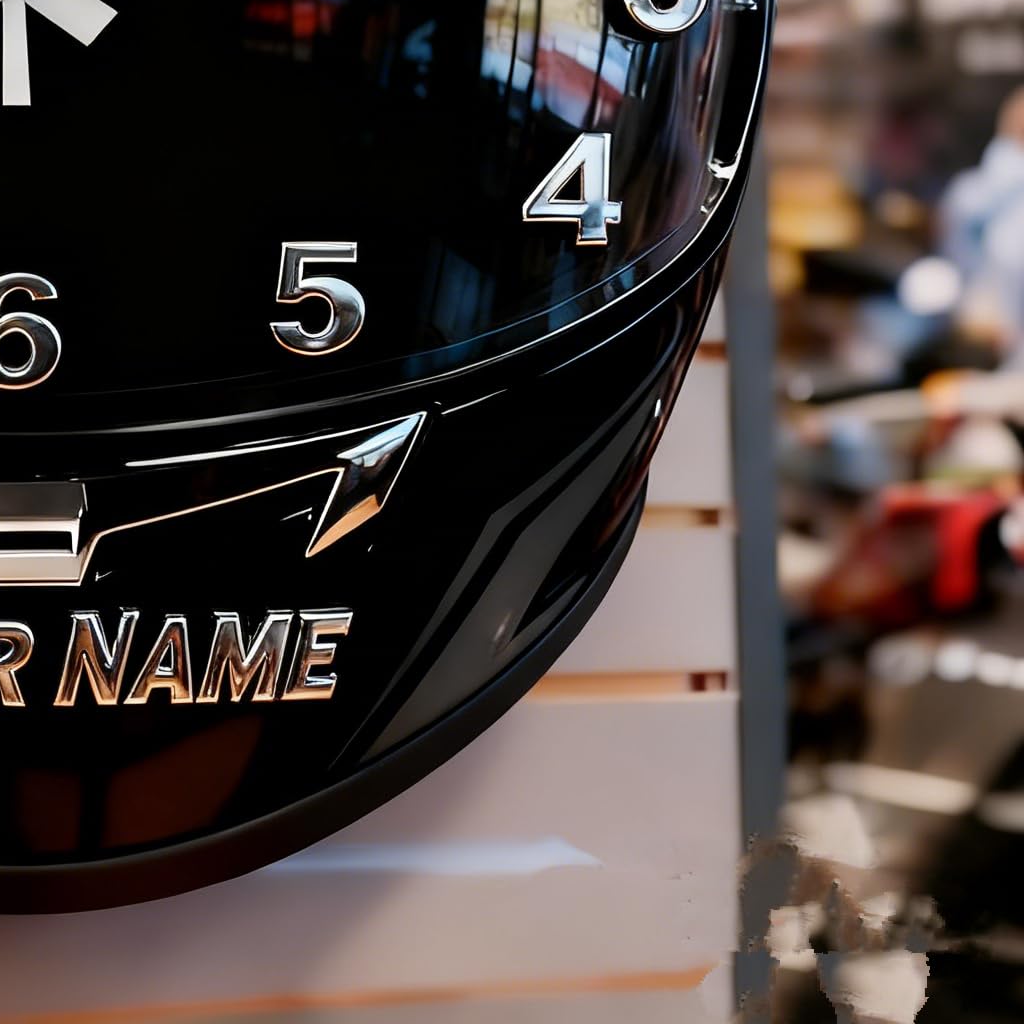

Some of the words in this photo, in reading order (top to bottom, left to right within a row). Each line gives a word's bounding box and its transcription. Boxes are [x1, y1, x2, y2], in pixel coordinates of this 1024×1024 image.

[522, 131, 622, 246] 4
[269, 241, 366, 356] 5
[52, 608, 354, 706] NAME
